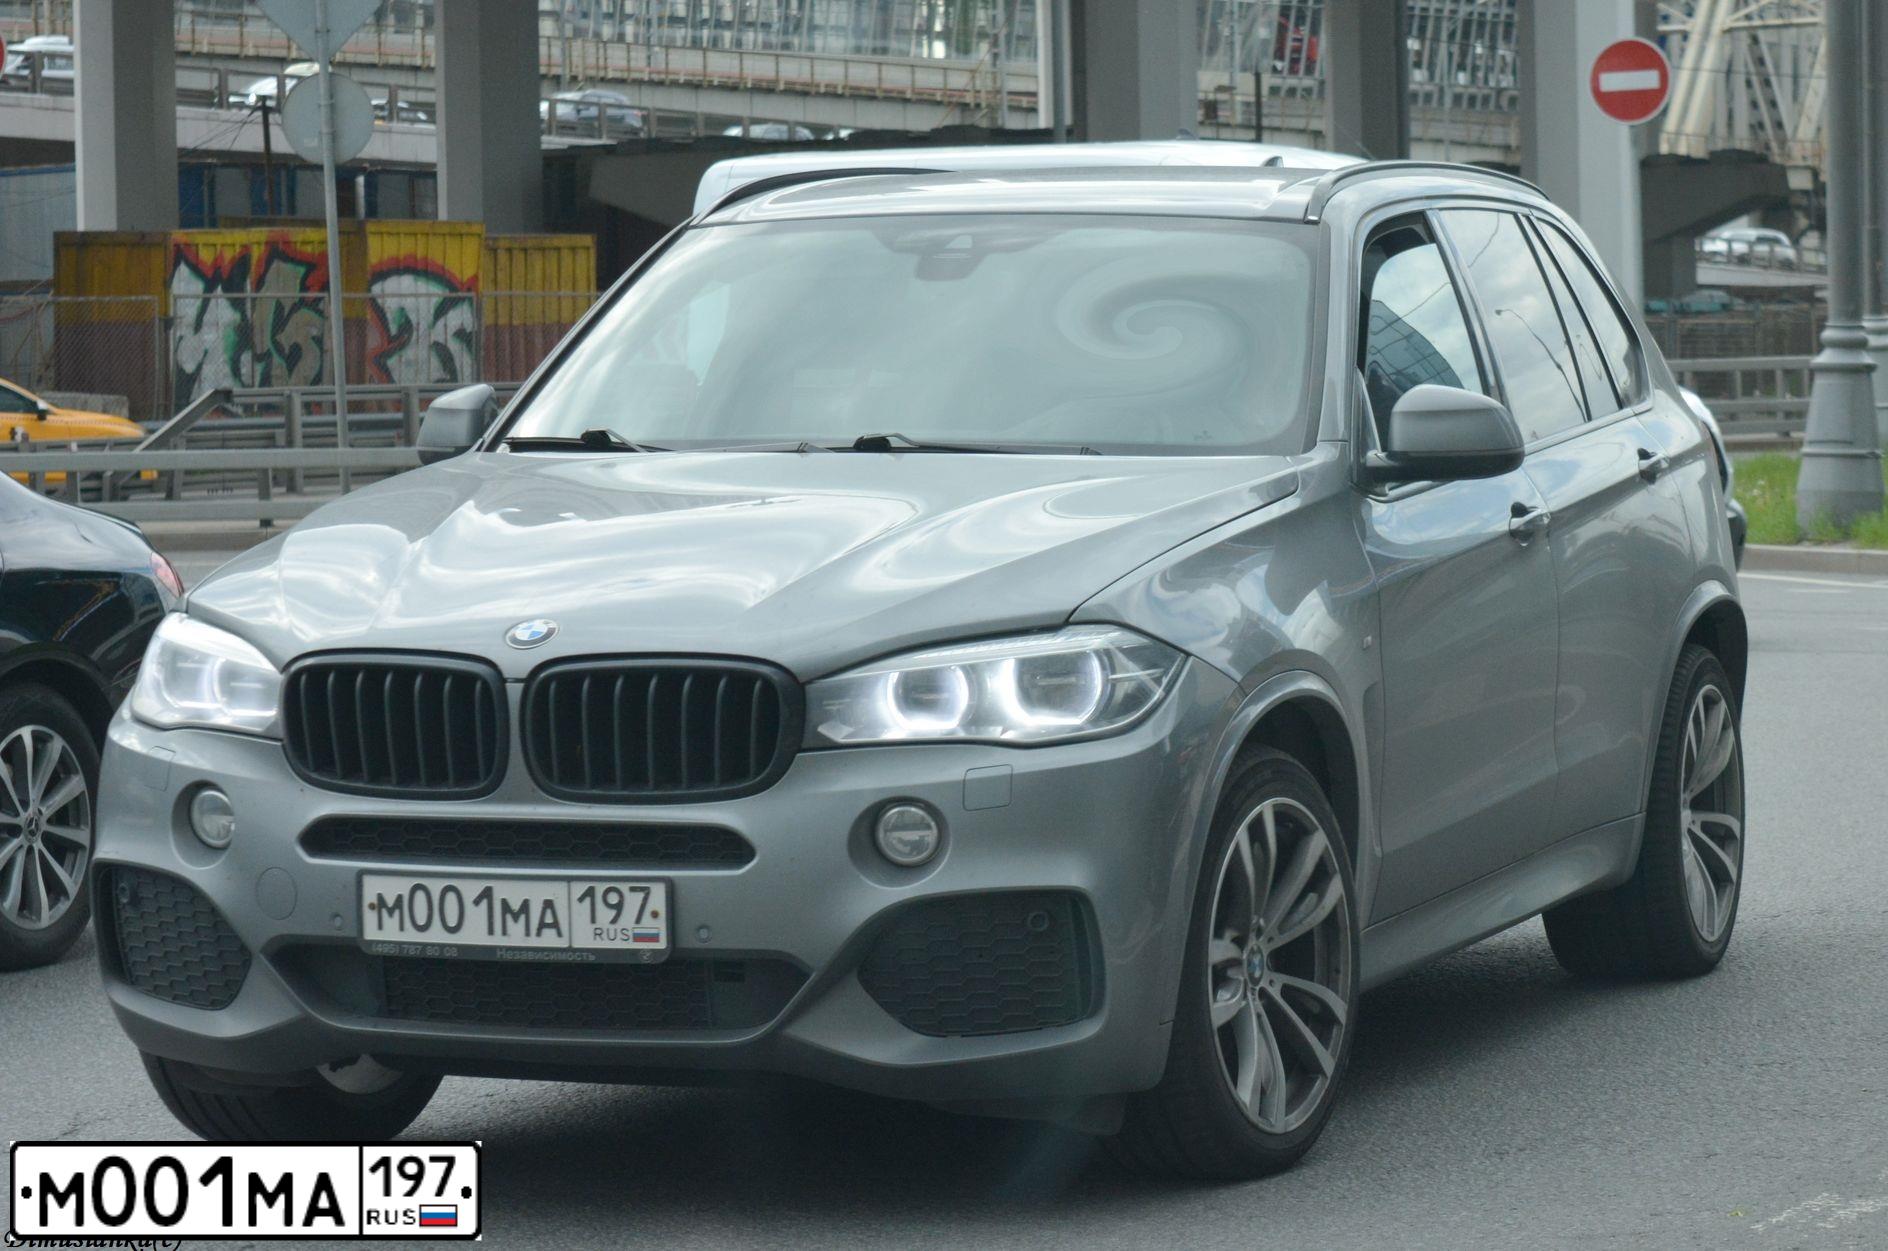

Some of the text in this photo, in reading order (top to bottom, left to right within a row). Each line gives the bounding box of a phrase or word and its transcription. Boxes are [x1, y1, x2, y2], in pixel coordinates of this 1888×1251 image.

[577, 885, 651, 925] 197
[593, 927, 630, 941] RUS
[371, 942, 400, 956] (495)
[496, 948, 596, 961] Независимость
